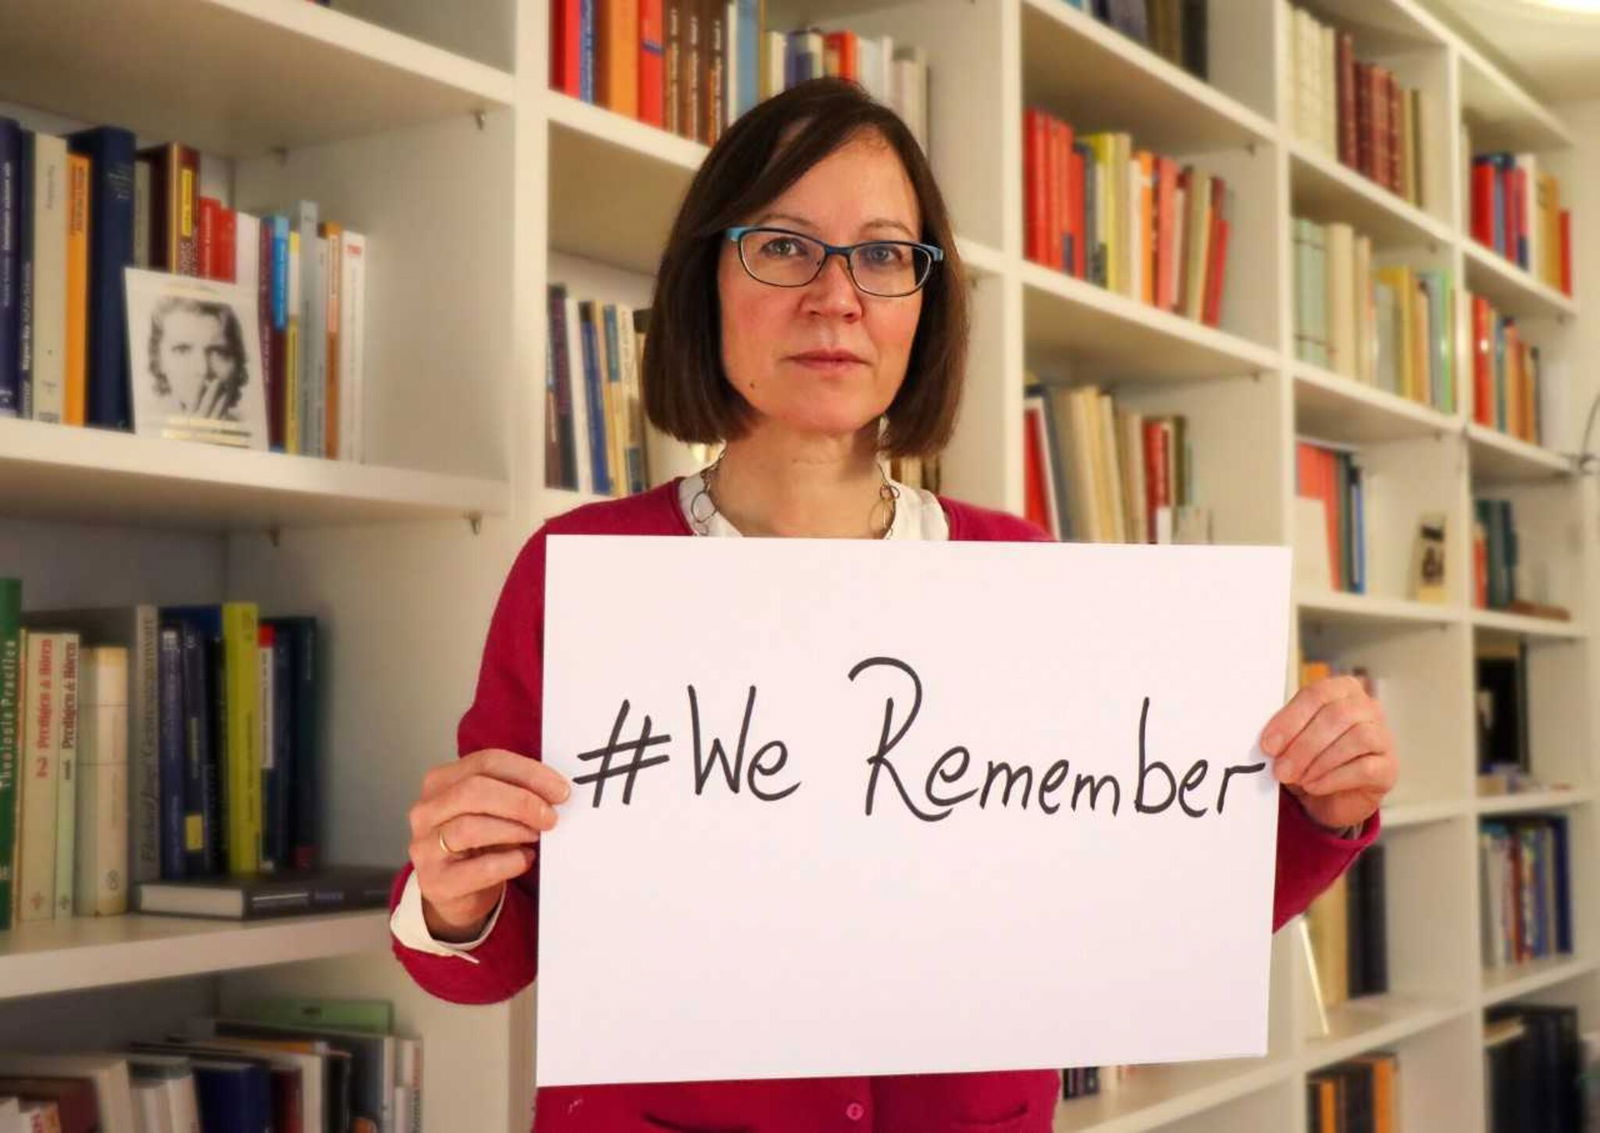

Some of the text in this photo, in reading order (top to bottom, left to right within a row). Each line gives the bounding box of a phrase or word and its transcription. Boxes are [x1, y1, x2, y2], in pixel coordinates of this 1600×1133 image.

[61, 692, 77, 750] Predigen
[572, 656, 1266, 822] #We Remember
[35, 756, 49, 779] 2
